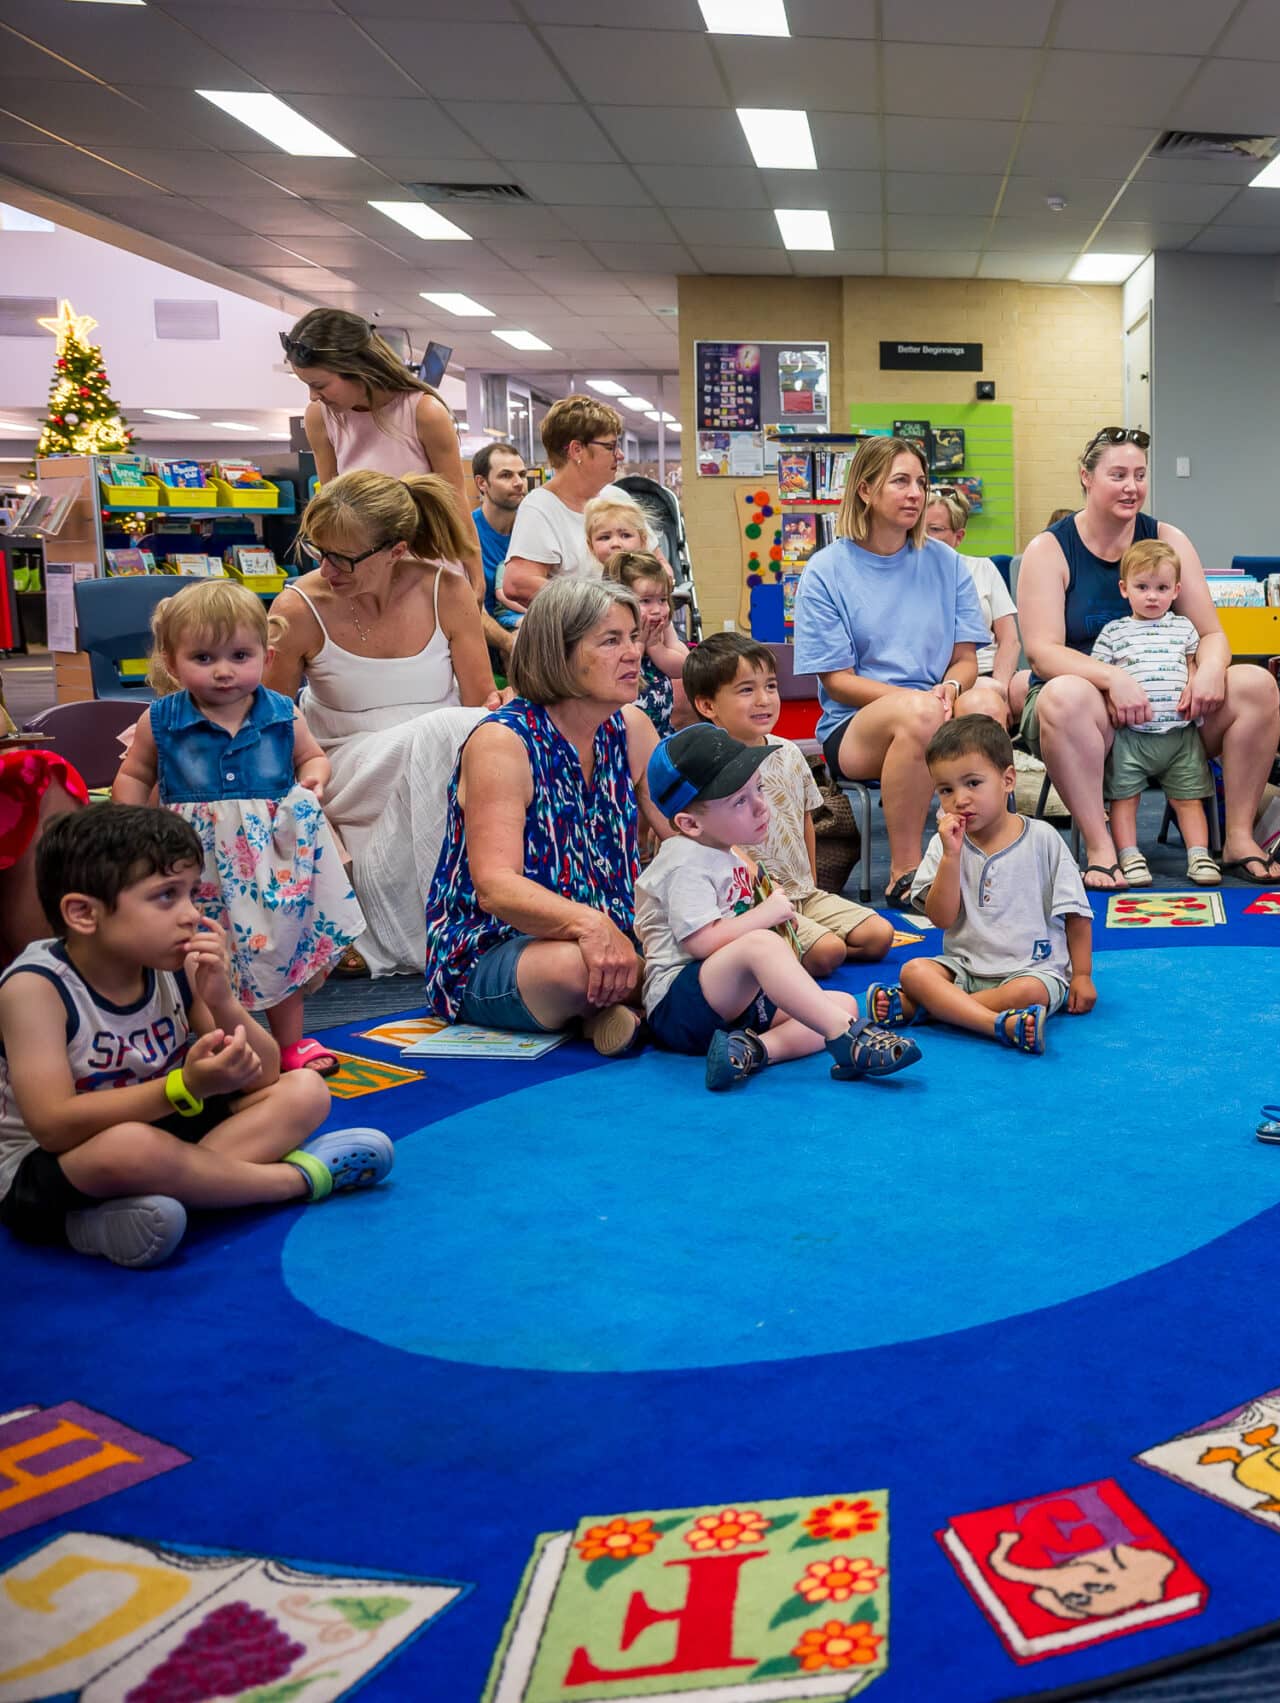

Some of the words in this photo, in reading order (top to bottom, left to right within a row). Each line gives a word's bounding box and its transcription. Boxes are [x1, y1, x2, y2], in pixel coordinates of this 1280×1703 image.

[897, 345, 921, 354] Better
[922, 345, 965, 356] Beginnings
[561, 1549, 769, 1688] F
